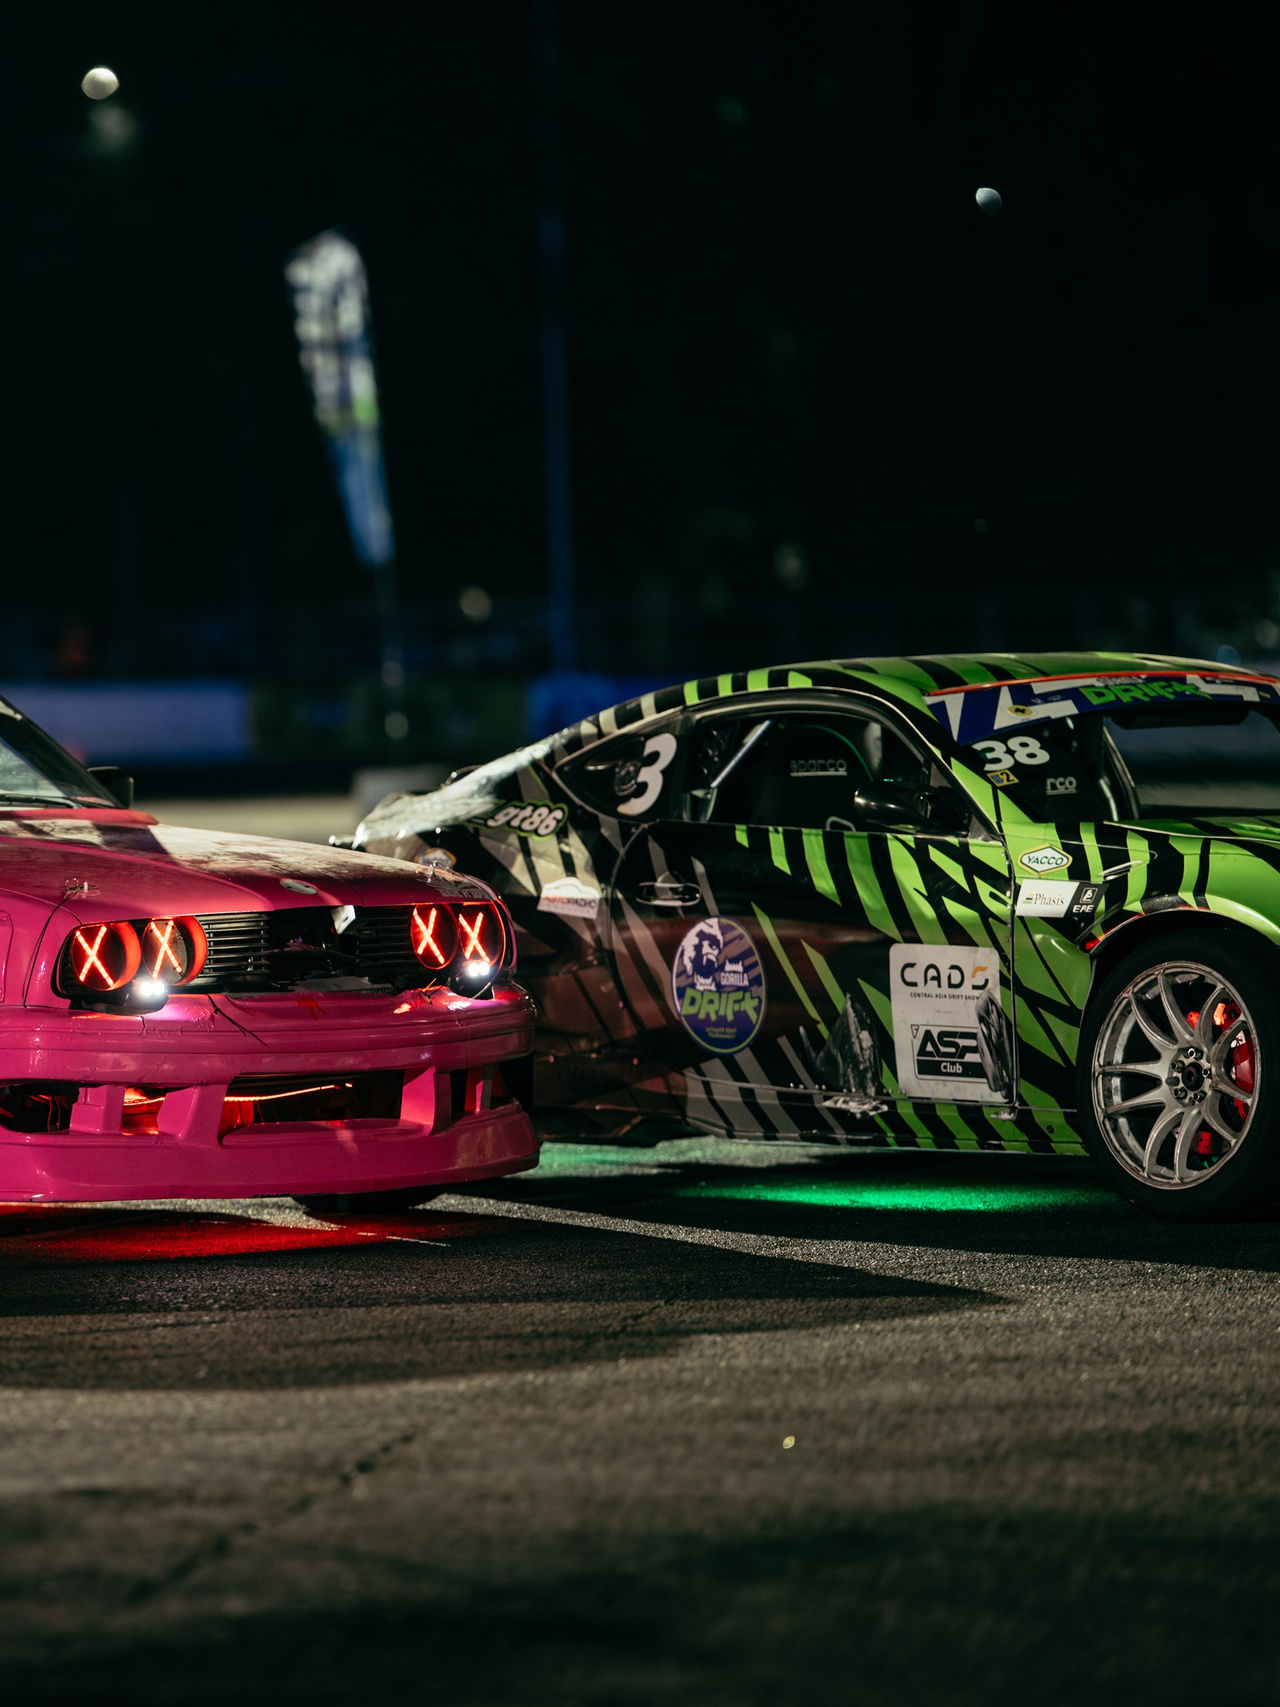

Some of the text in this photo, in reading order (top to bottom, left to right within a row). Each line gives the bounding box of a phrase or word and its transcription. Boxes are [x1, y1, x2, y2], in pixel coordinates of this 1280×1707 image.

[971, 736, 1051, 771] 38
[1027, 855, 1064, 866] YACCO
[1034, 893, 1065, 906] Phasis
[720, 972, 749, 987] GORILLA
[900, 962, 989, 990] CADS
[916, 1029, 980, 1060] ASP
[940, 1062, 963, 1073] Club
